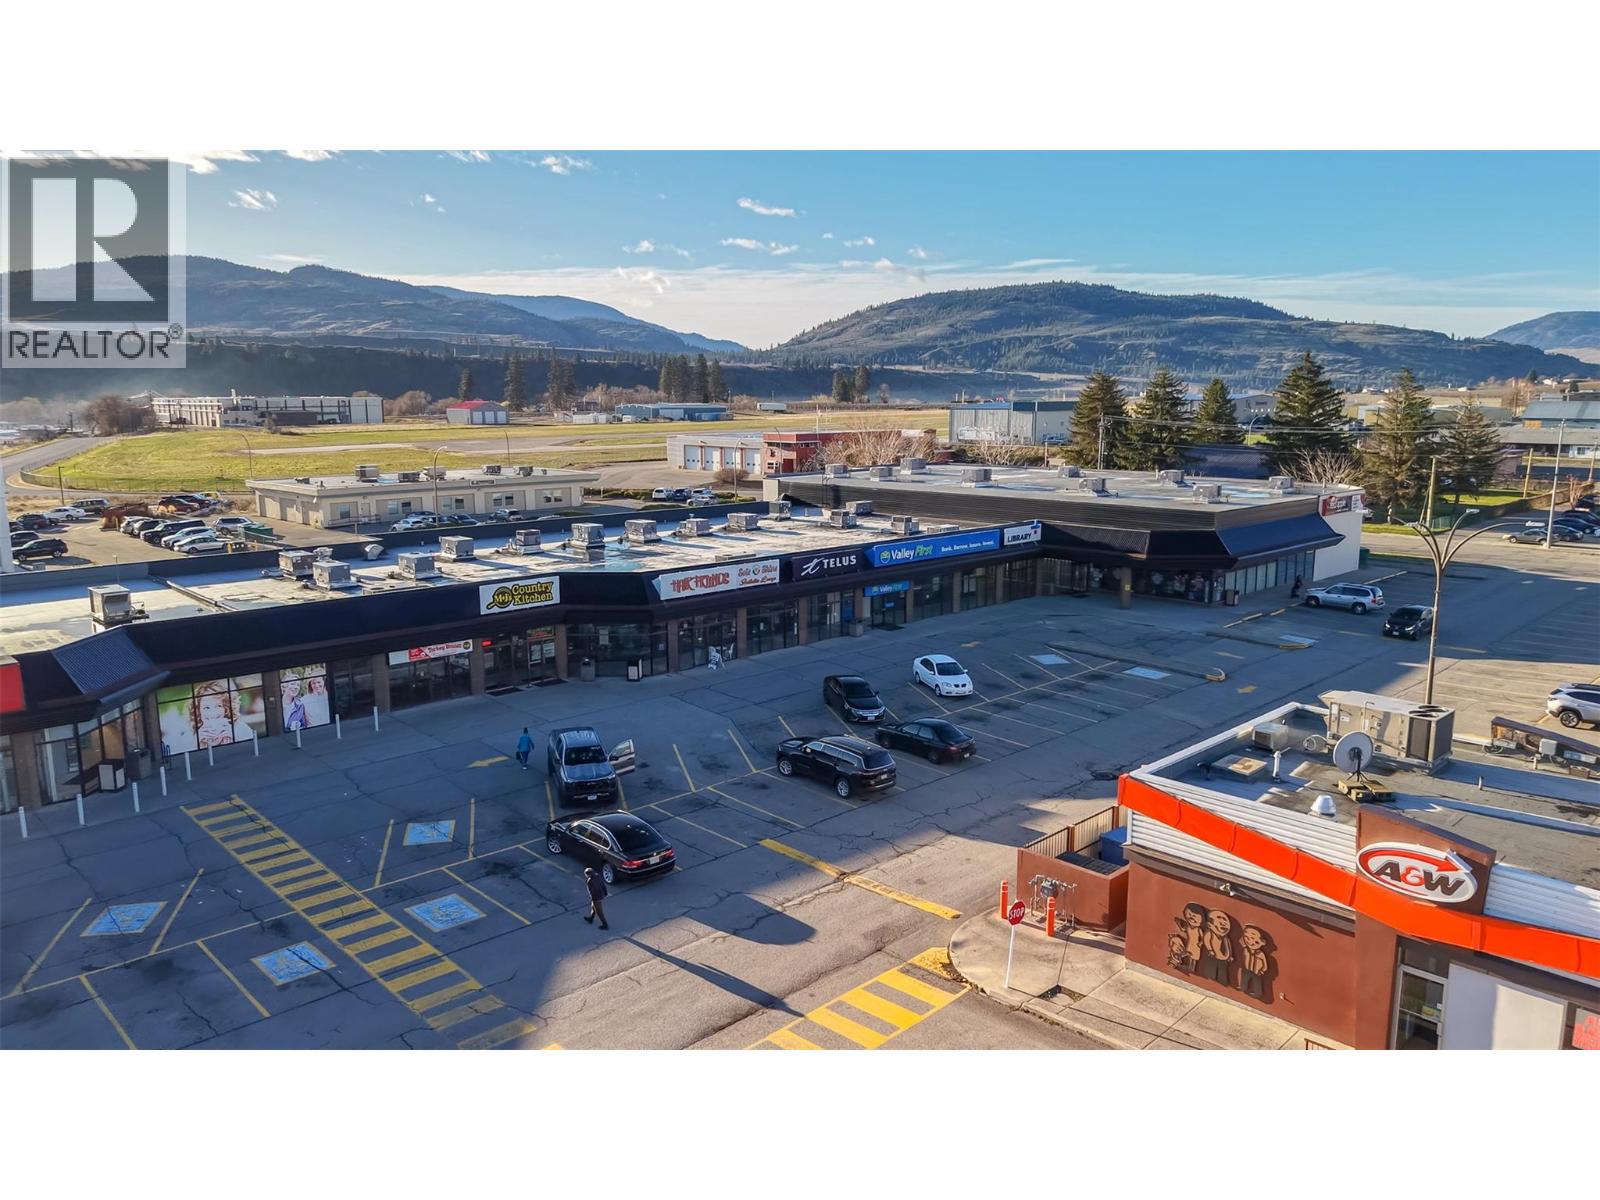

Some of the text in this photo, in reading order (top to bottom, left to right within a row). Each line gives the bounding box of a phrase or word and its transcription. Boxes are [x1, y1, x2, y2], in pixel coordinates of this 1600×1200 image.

[1007, 533, 1032, 543] LIBRARY
[891, 543, 933, 561] Valley First
[822, 555, 857, 569] TELUS
[512, 582, 554, 595] Country
[513, 592, 554, 605] Kitchen
[1373, 860, 1466, 896] A&W
[1009, 907, 1025, 919] STOP
